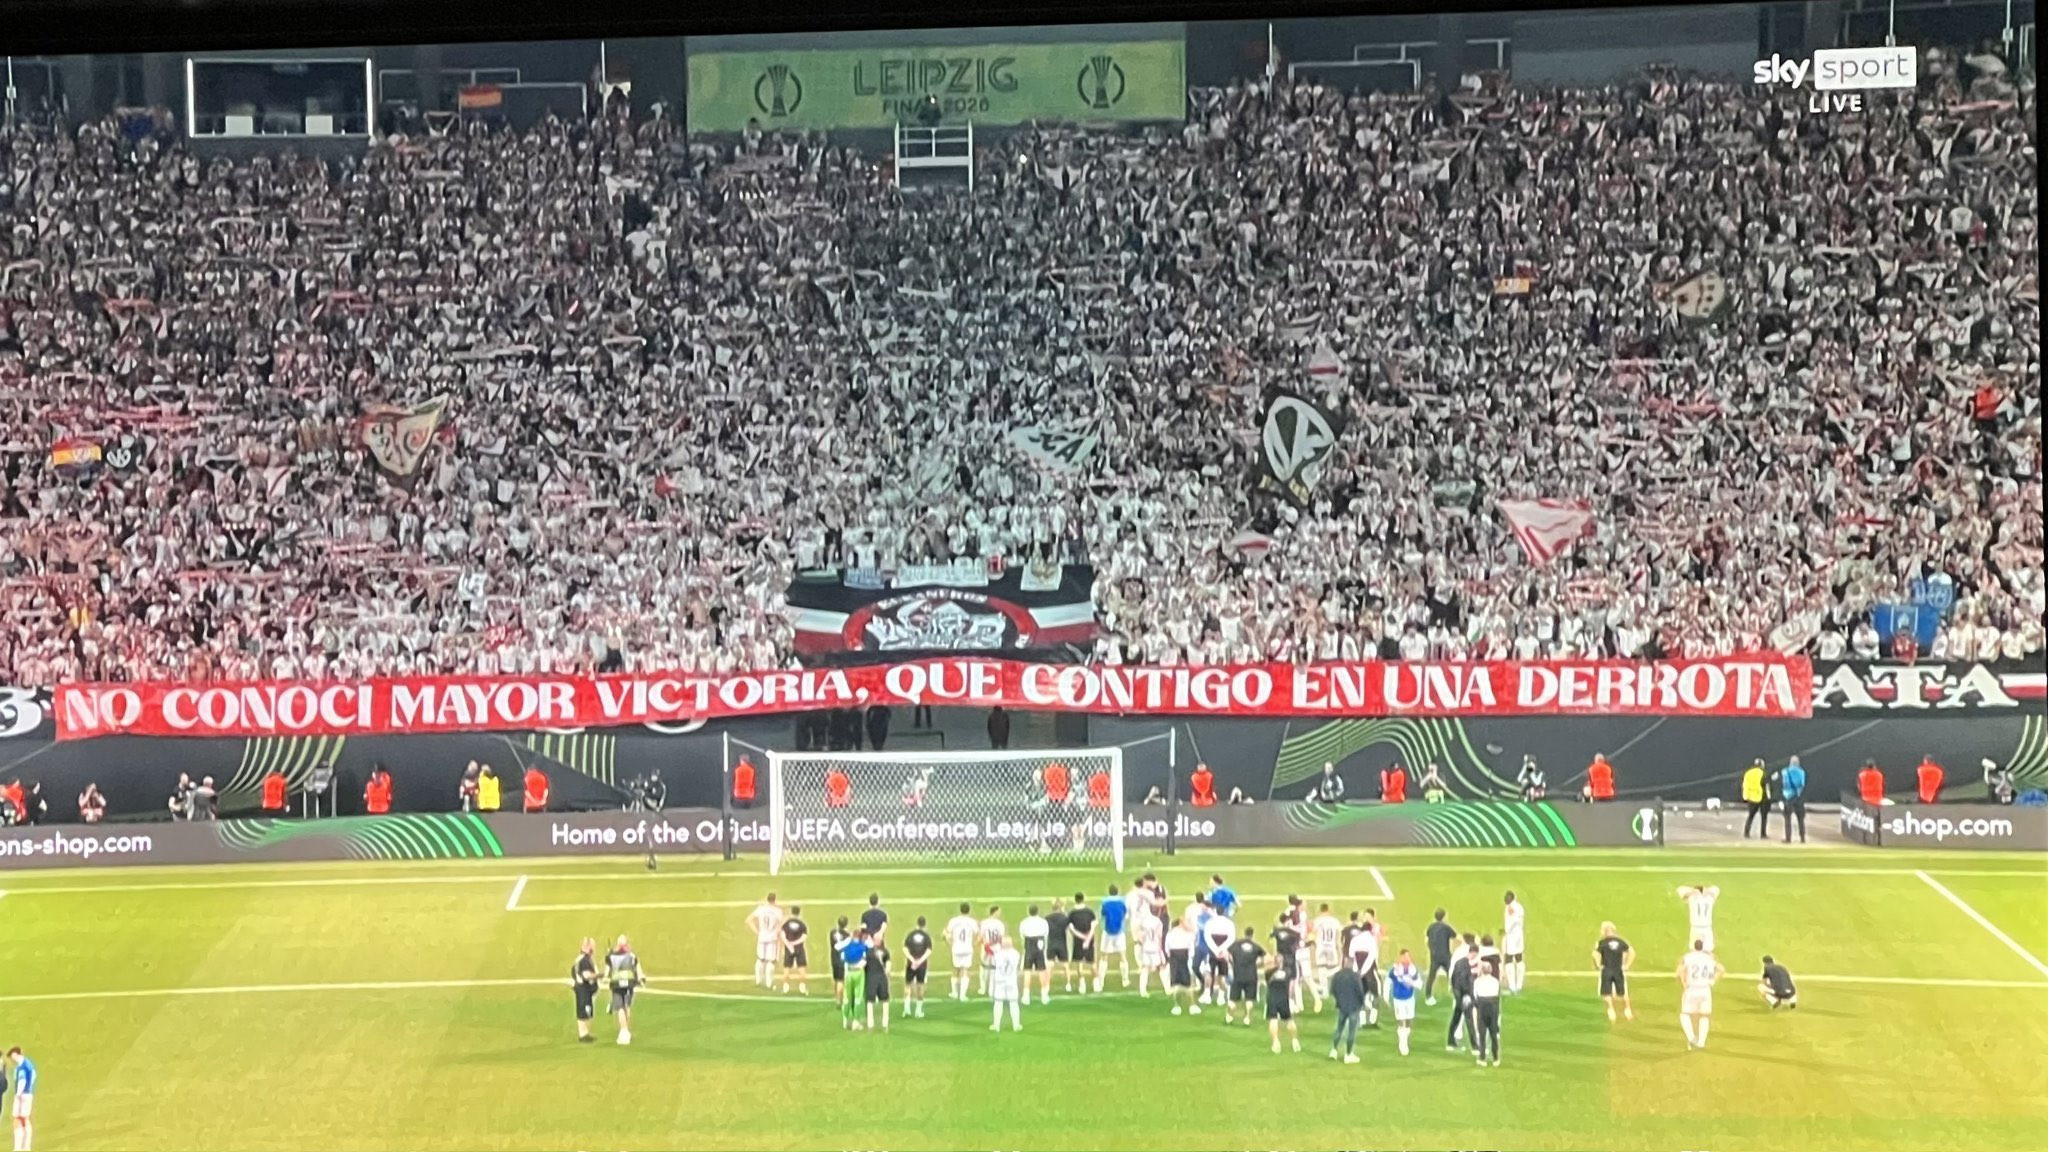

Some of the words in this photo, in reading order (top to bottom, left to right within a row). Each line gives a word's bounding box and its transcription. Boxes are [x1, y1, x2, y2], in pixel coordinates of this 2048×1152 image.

[853, 56, 1019, 96] LEIPZIG
[64, 687, 142, 731] NO
[162, 684, 372, 730] CONOCI
[390, 681, 576, 724] MAYOR
[596, 670, 869, 718] VICTORIA,
[885, 661, 1002, 704] QUE
[1021, 664, 1272, 708] CONTIGO
[1291, 664, 1367, 708] EN
[1382, 664, 1496, 707] UNA
[1516, 661, 1798, 712] DERROTA
[551, 823, 616, 845] Home
[622, 820, 646, 844] of
[652, 822, 689, 843] the
[785, 817, 846, 842] UEFA
[851, 815, 979, 841] Conference
